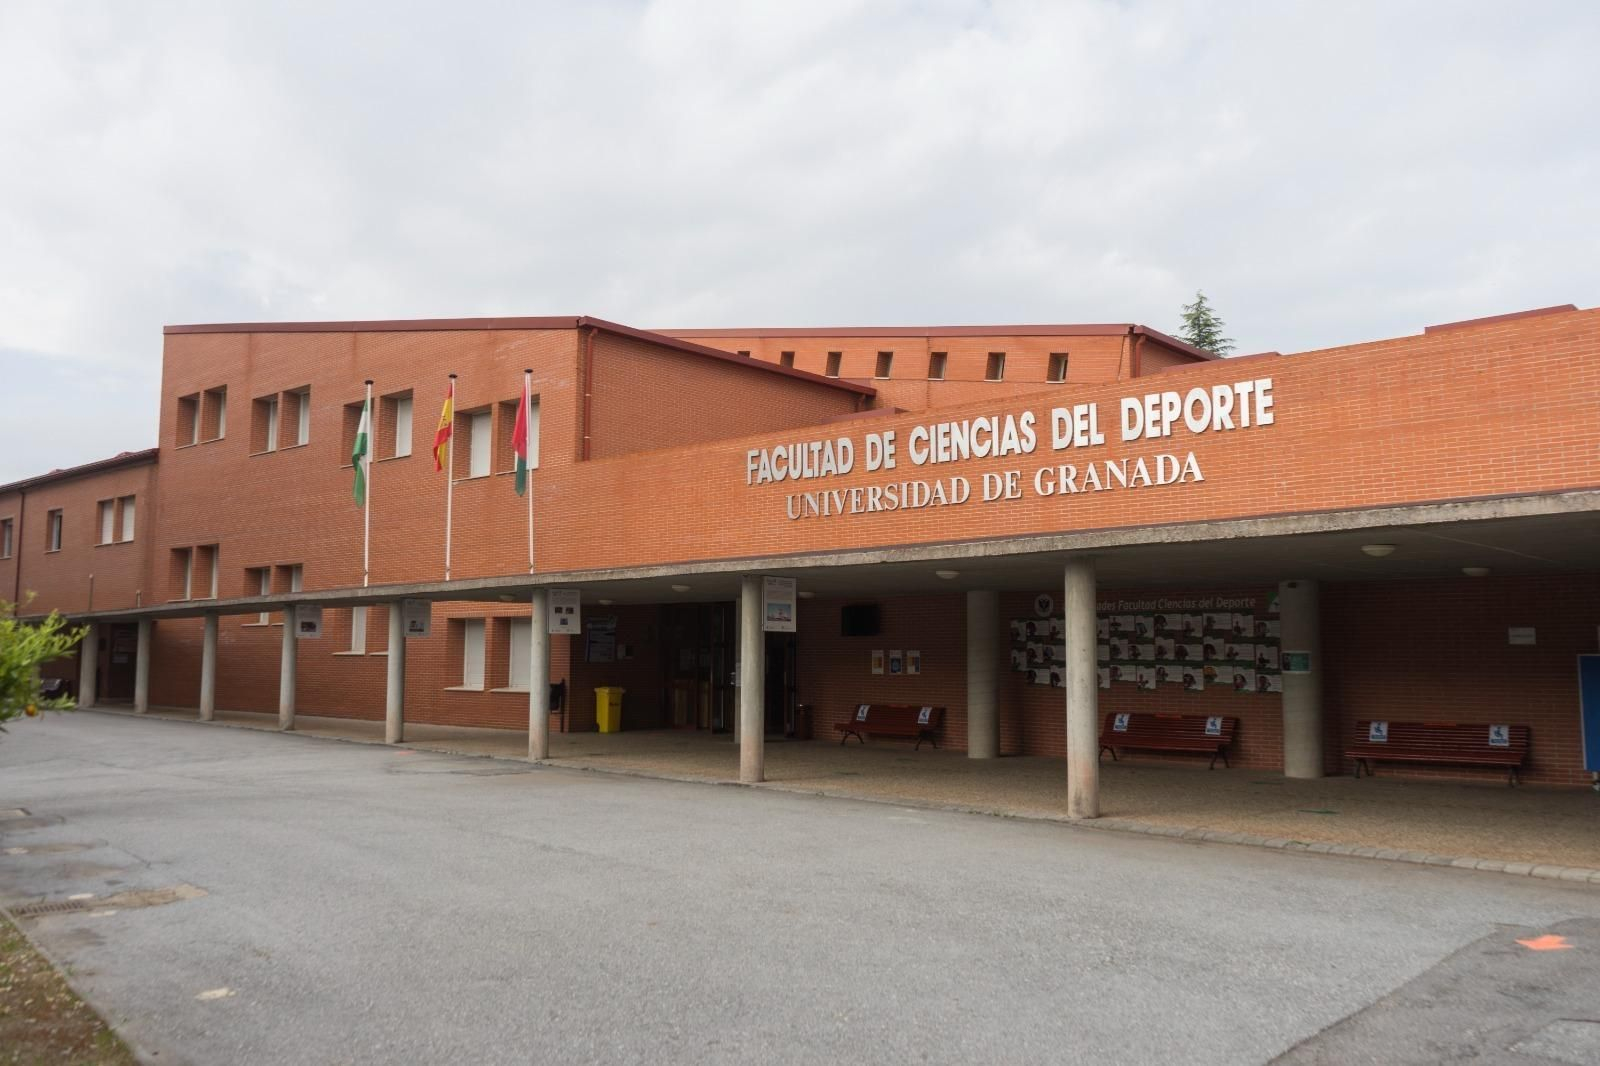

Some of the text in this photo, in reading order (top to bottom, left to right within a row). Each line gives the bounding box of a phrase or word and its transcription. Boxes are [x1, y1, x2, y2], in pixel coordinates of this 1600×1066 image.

[746, 378, 1275, 485] FACULTAD DE CIENCIAS DEL DEPORTE
[786, 452, 1205, 520] UNIVERSIDAD DE GRANADA
[1118, 599, 1157, 610] Facultad
[1158, 598, 1197, 609] Ciencias
[1198, 596, 1213, 608] del
[1216, 597, 1256, 610] Deporte
